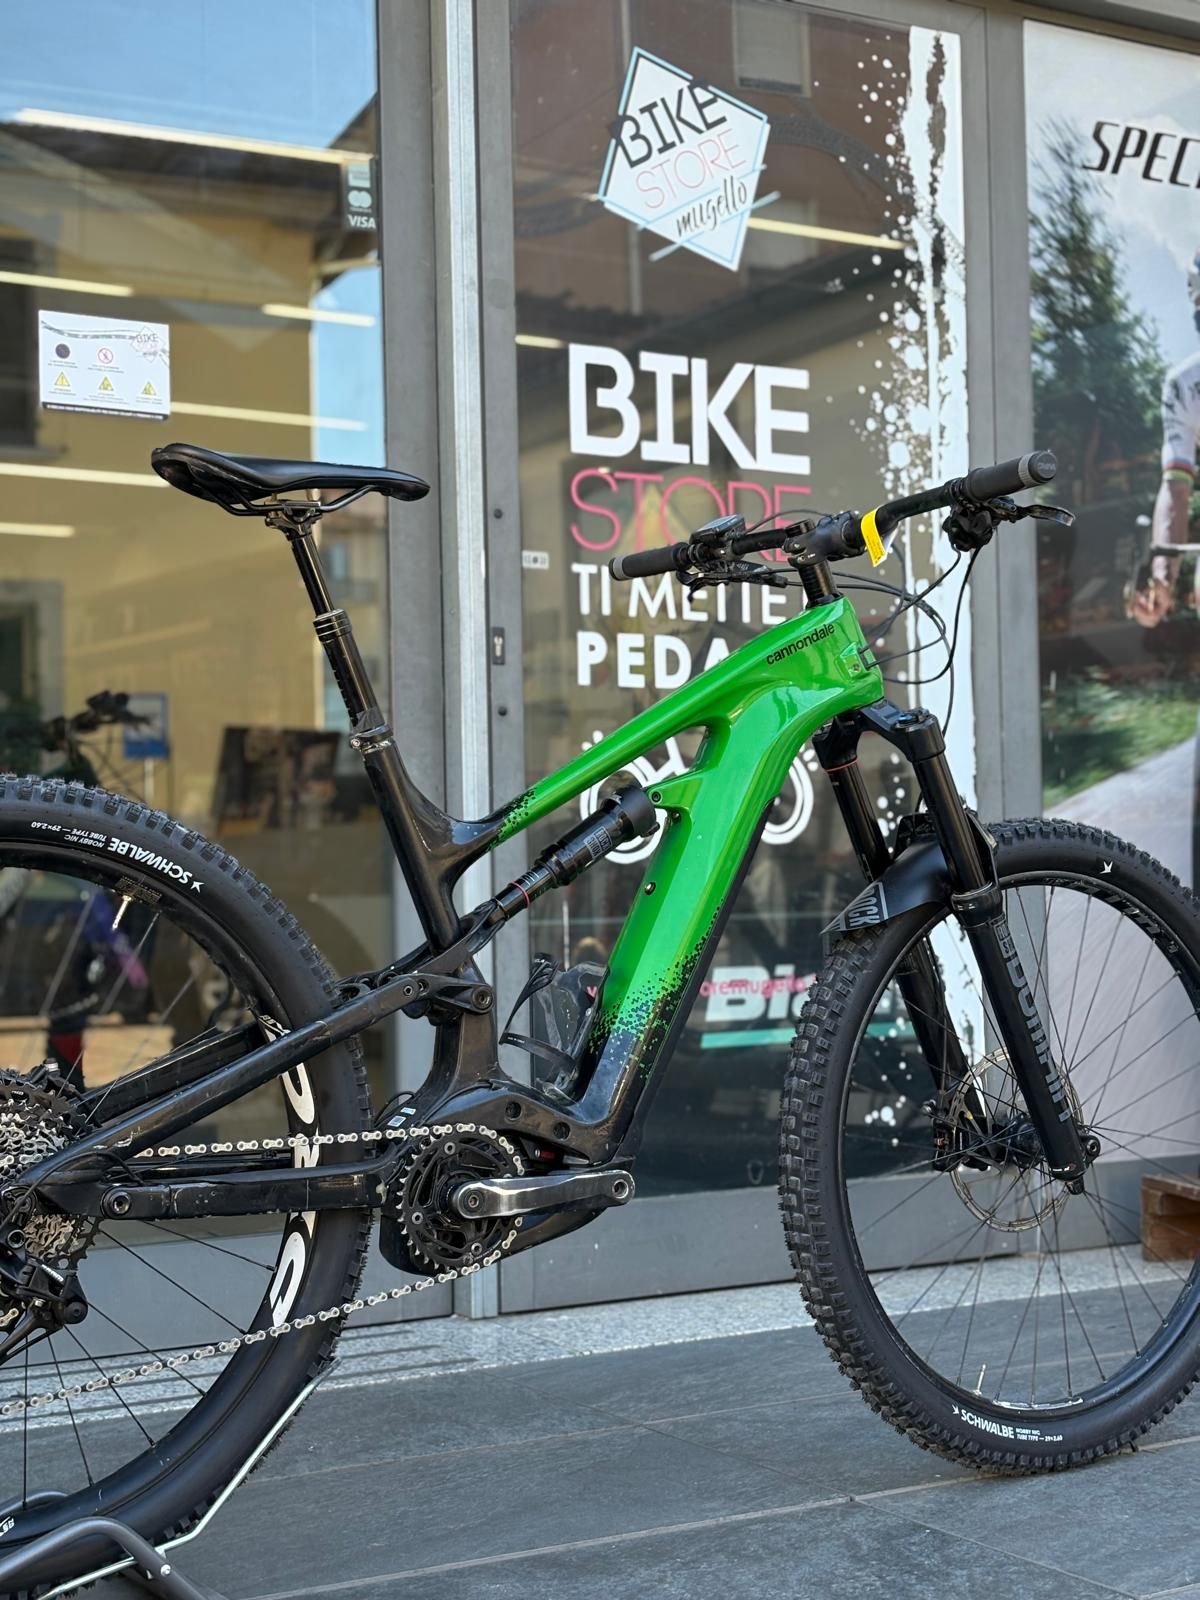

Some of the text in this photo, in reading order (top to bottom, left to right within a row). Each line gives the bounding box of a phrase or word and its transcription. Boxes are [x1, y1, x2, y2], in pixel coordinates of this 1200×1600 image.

[609, 79, 728, 169] BIKE
[636, 128, 747, 209] STORE
[1081, 120, 1200, 190] SPEC
[347, 213, 377, 229] VISA
[568, 343, 811, 475] BIKE
[766, 623, 836, 666] cannondale
[107, 837, 193, 885] SCHWALBE
[961, 1408, 1015, 1439] SCHWALBE
